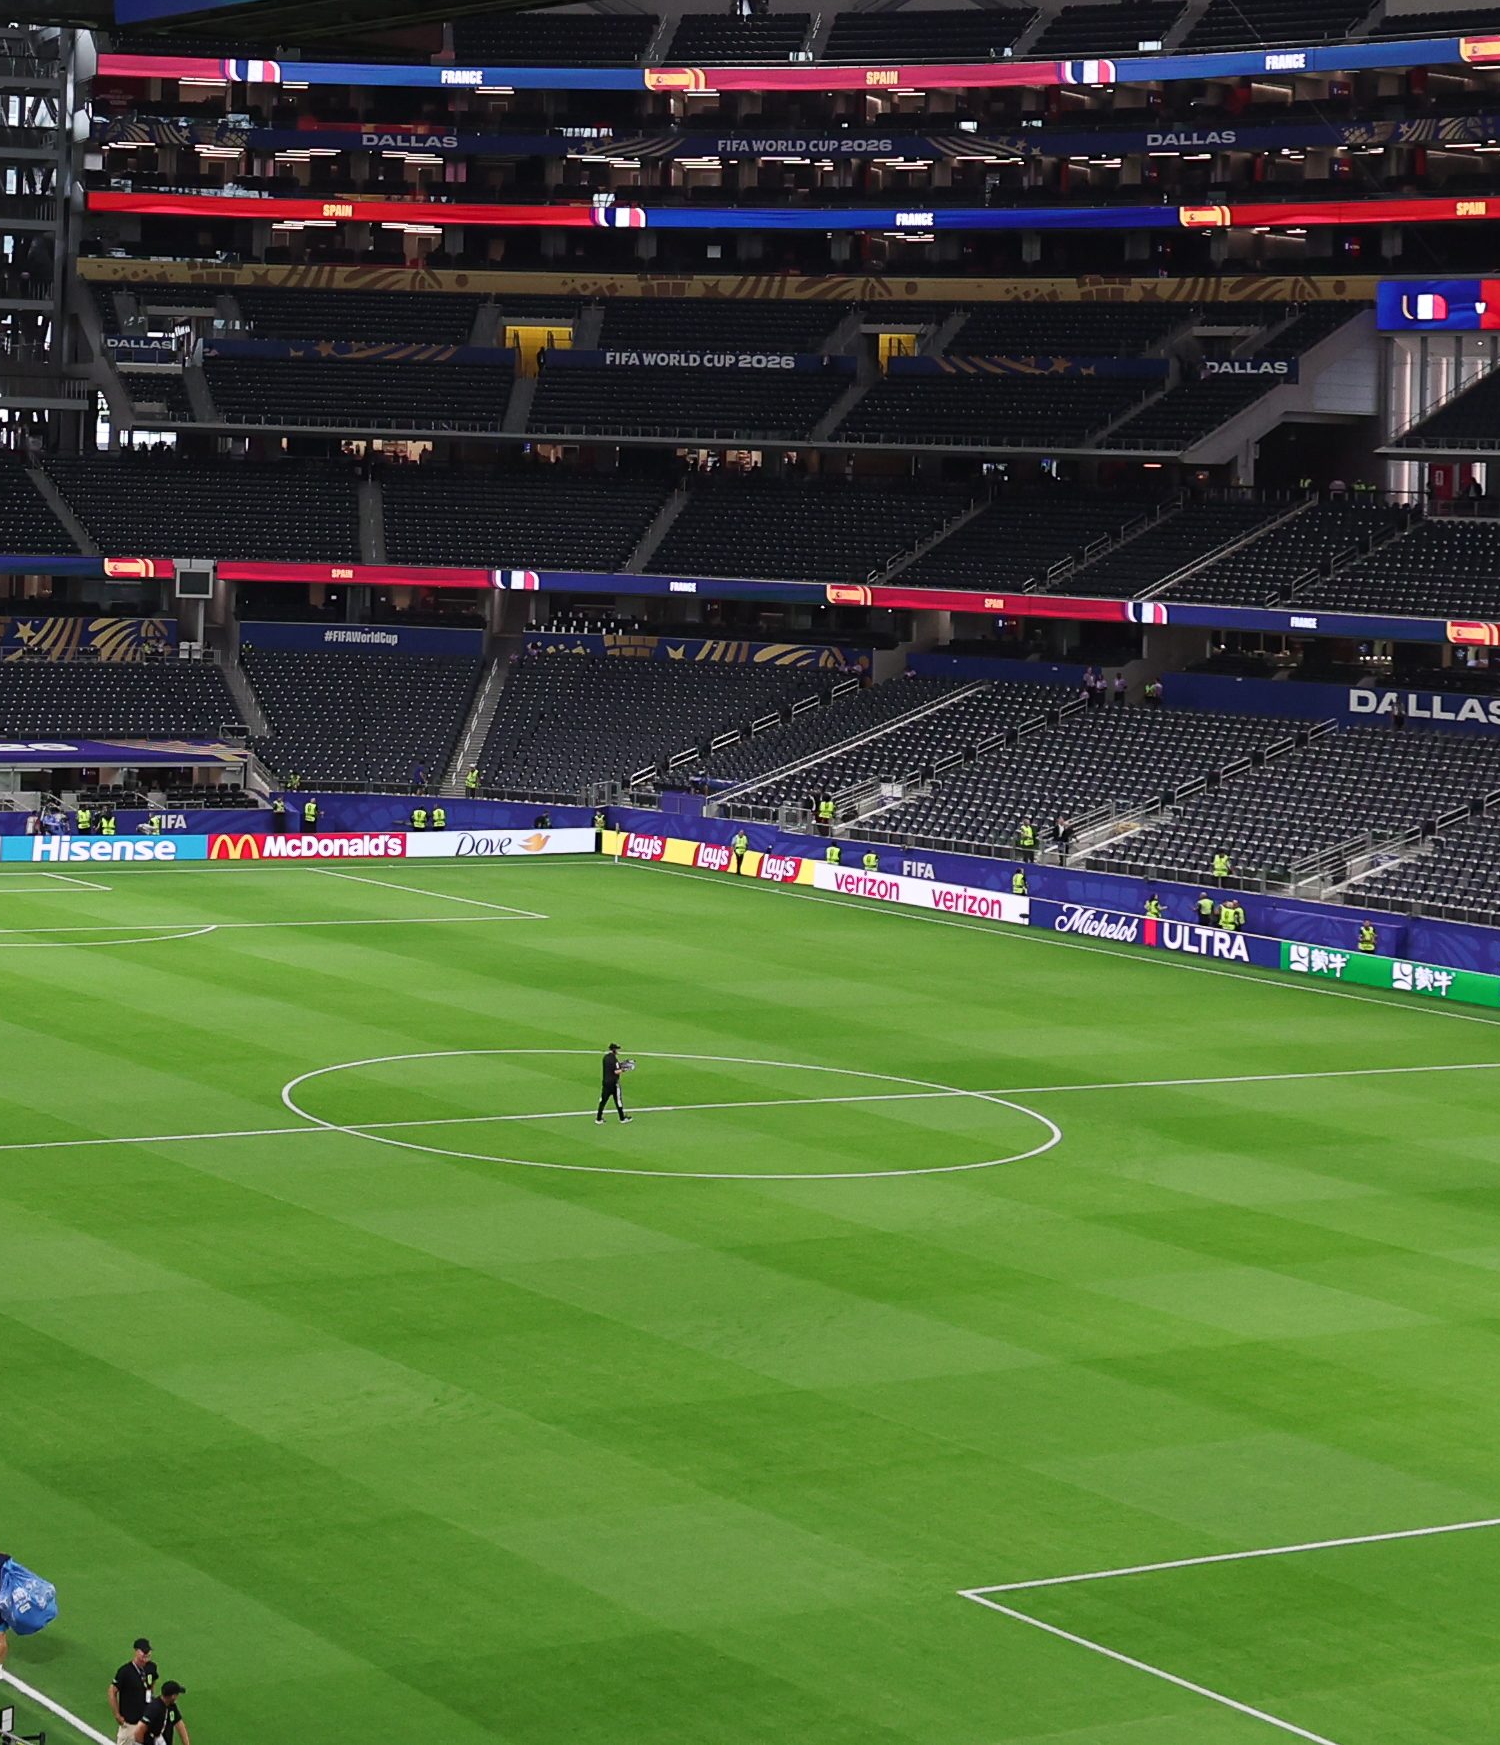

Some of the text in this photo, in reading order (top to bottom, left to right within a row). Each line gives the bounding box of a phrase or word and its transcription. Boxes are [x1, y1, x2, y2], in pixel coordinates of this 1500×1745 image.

[1266, 52, 1305, 70] FRANCE
[441, 70, 483, 84] FRANCE
[867, 70, 899, 84] SPAIN
[361, 134, 459, 148] DALLAS
[717, 138, 892, 153] FIFA WORLD CUP 2026
[1146, 130, 1237, 146] DALLAS
[323, 205, 352, 216] SPAIN
[1457, 202, 1485, 215] SPAIN
[896, 213, 933, 226] FRANCE
[106, 337, 173, 350] DALLAS
[606, 353, 794, 368] FIFA WORLD CUP 2026
[1206, 361, 1288, 374] DALLAS
[332, 569, 353, 578] SPAIN
[670, 582, 696, 592] FRANCE
[1291, 617, 1317, 628] FRANCE
[325, 631, 397, 646] #FIFAWorldCup
[33, 836, 176, 862] Hisense
[264, 836, 402, 859] McDonald's
[456, 833, 512, 856] Dove
[626, 834, 663, 861] Lay's
[697, 842, 731, 871] Lay's
[761, 854, 796, 882] Lay's
[903, 860, 936, 880] FIFA
[834, 871, 900, 902] verizon
[931, 885, 1003, 919] verizon
[1054, 904, 1250, 963] Michelob ULTRA
